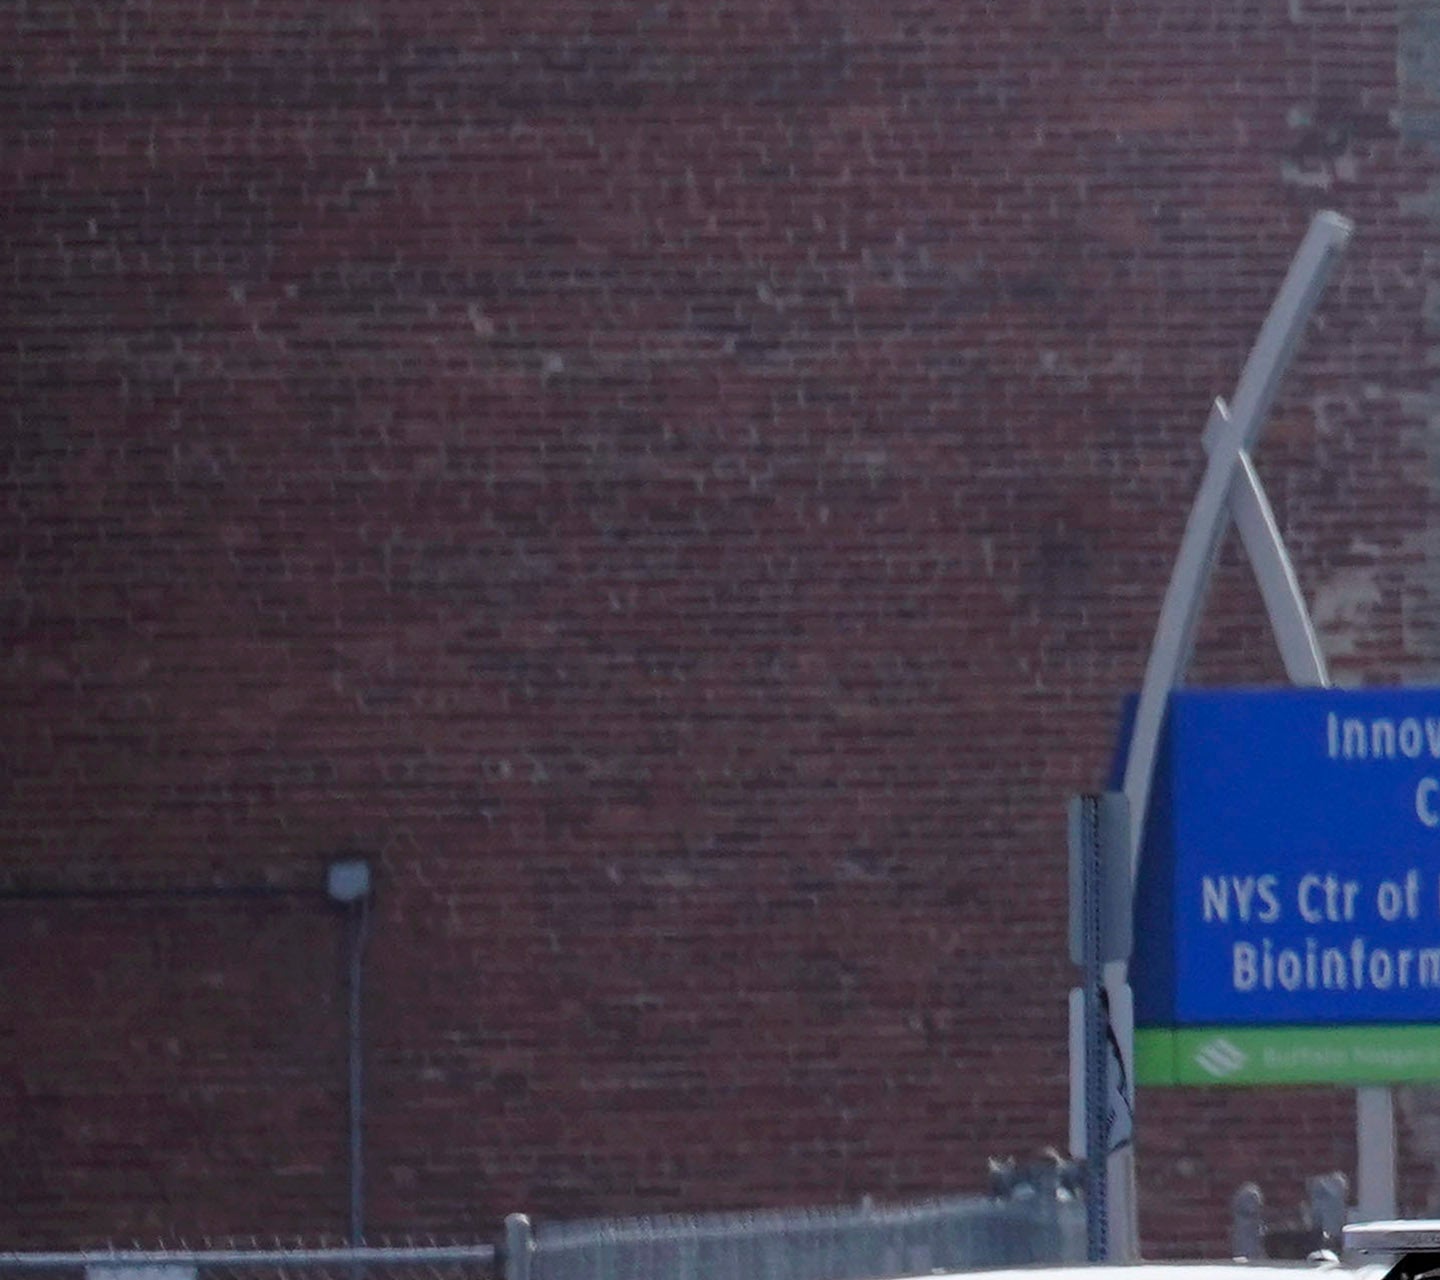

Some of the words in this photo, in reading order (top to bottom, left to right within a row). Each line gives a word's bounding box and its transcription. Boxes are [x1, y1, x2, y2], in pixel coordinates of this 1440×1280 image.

[1202, 872, 1281, 923] NYS
[1298, 871, 1359, 923] Ctr
[1377, 869, 1420, 921] of
